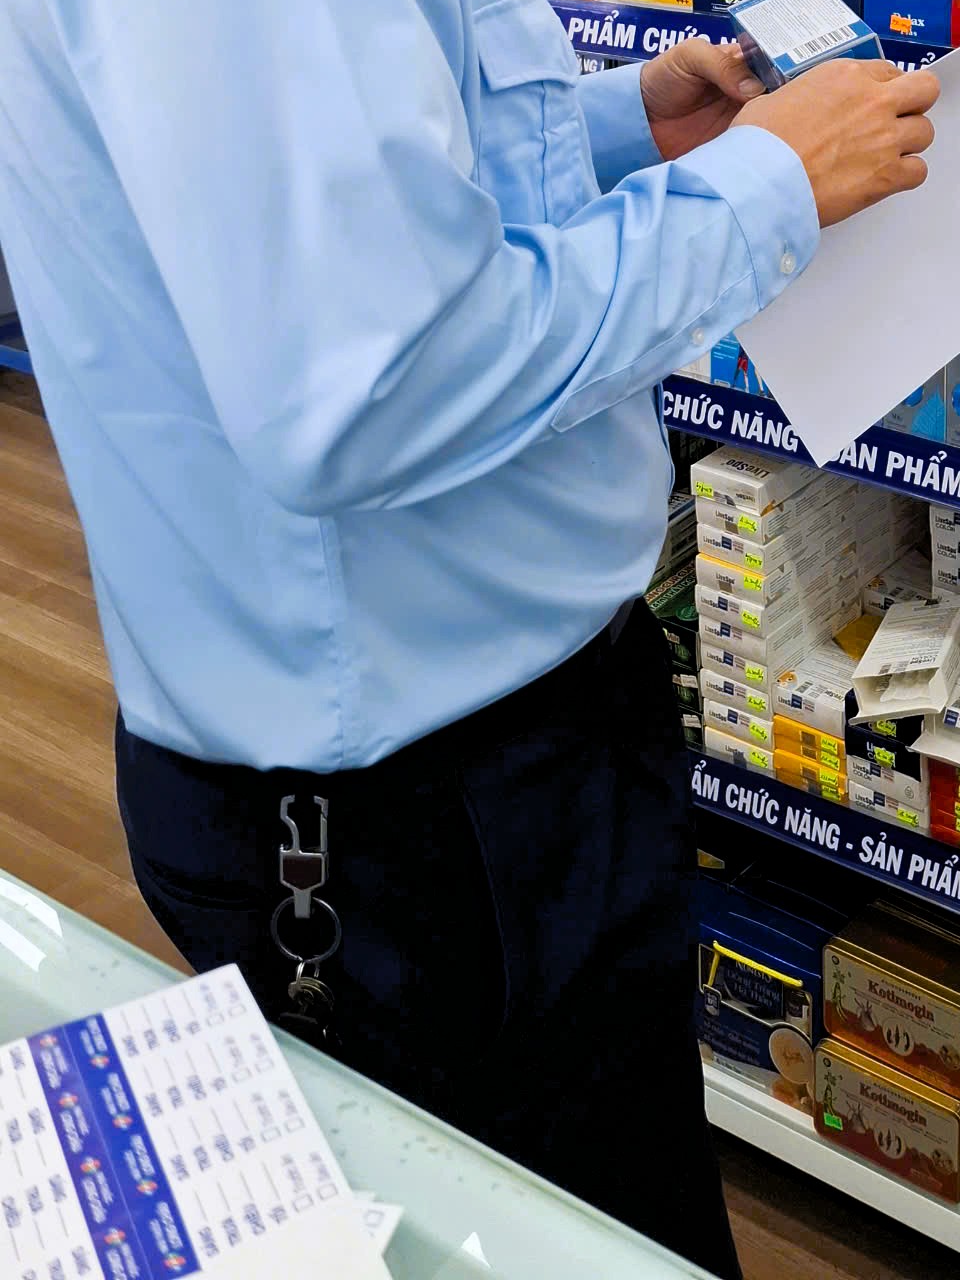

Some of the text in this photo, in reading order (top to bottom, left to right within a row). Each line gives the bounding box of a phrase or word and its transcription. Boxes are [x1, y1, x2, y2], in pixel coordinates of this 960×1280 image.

[568, 10, 637, 49] PHẨM
[662, 387, 723, 430] CHỨC
[731, 408, 799, 454] NĂNG
[691, 760, 719, 802] ẨM
[725, 780, 778, 823] CHỨC
[784, 802, 840, 851] NĂNG
[859, 832, 902, 876] SẢN
